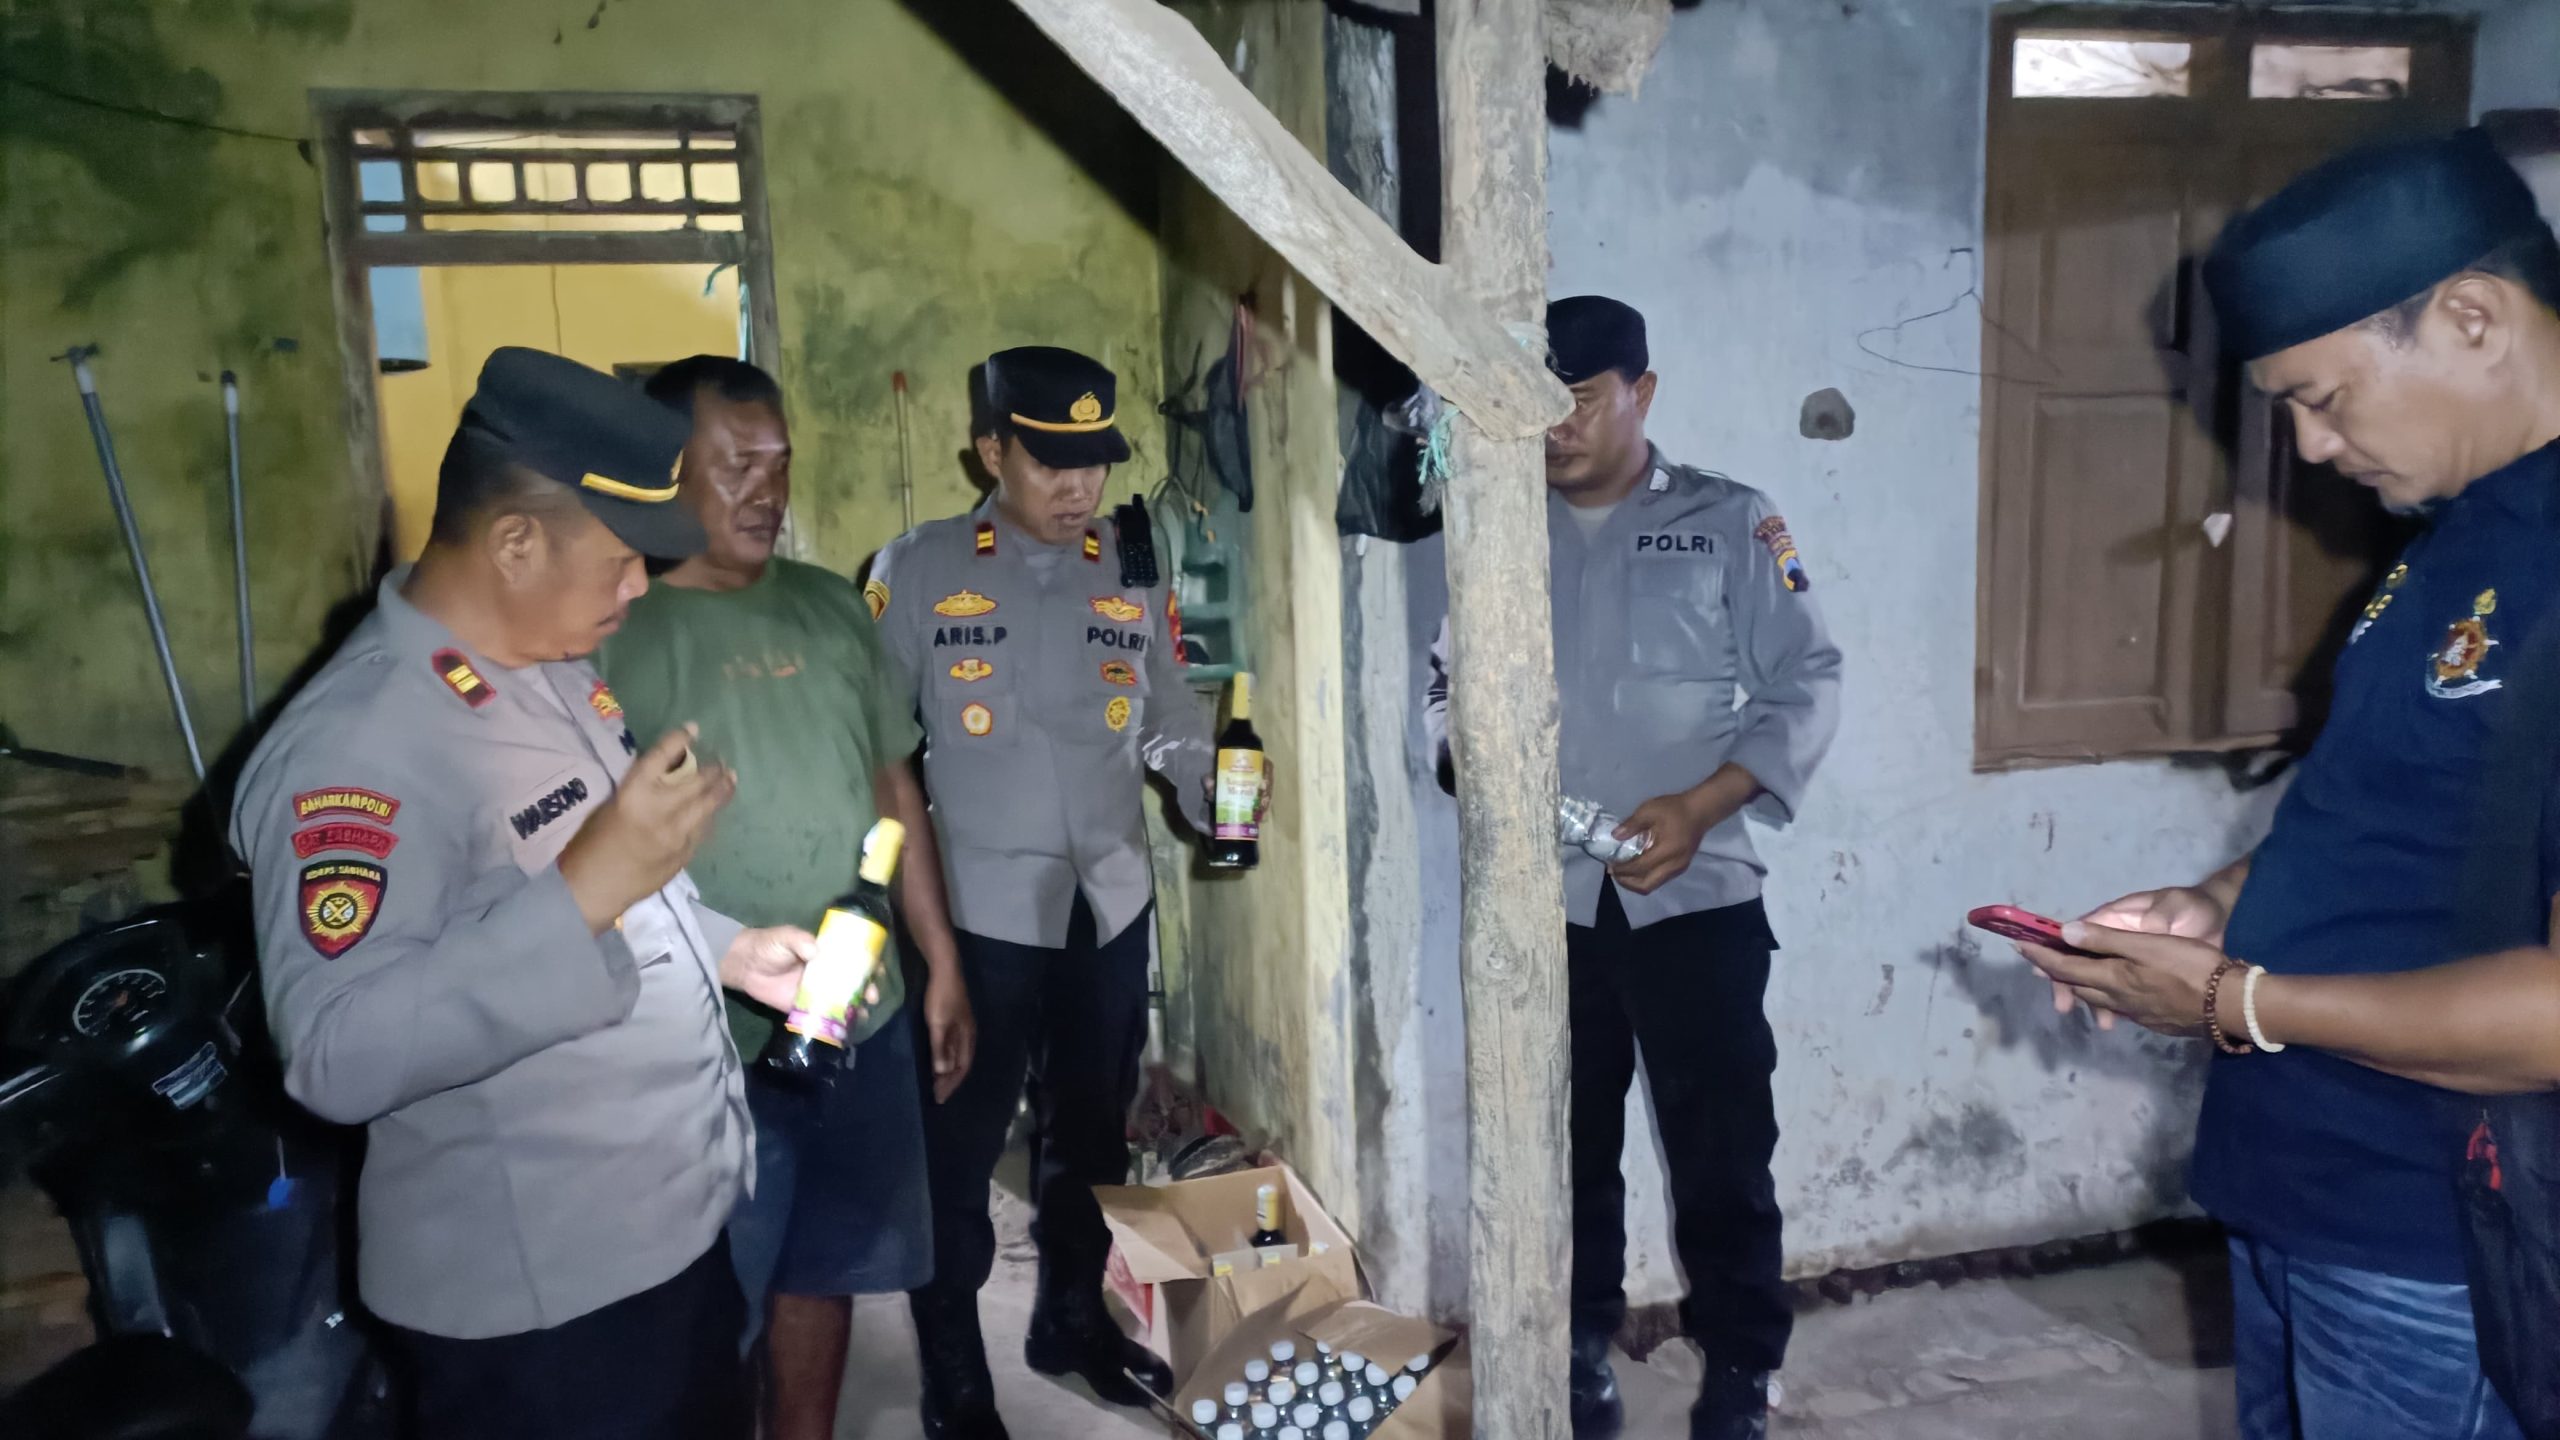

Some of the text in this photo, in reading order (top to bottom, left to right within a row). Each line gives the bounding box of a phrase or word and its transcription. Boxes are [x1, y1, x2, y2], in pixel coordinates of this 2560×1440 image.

[1636, 534, 1714, 554] POLRI
[933, 626, 1007, 648] ARIS.P
[1086, 626, 1148, 651] POLRI
